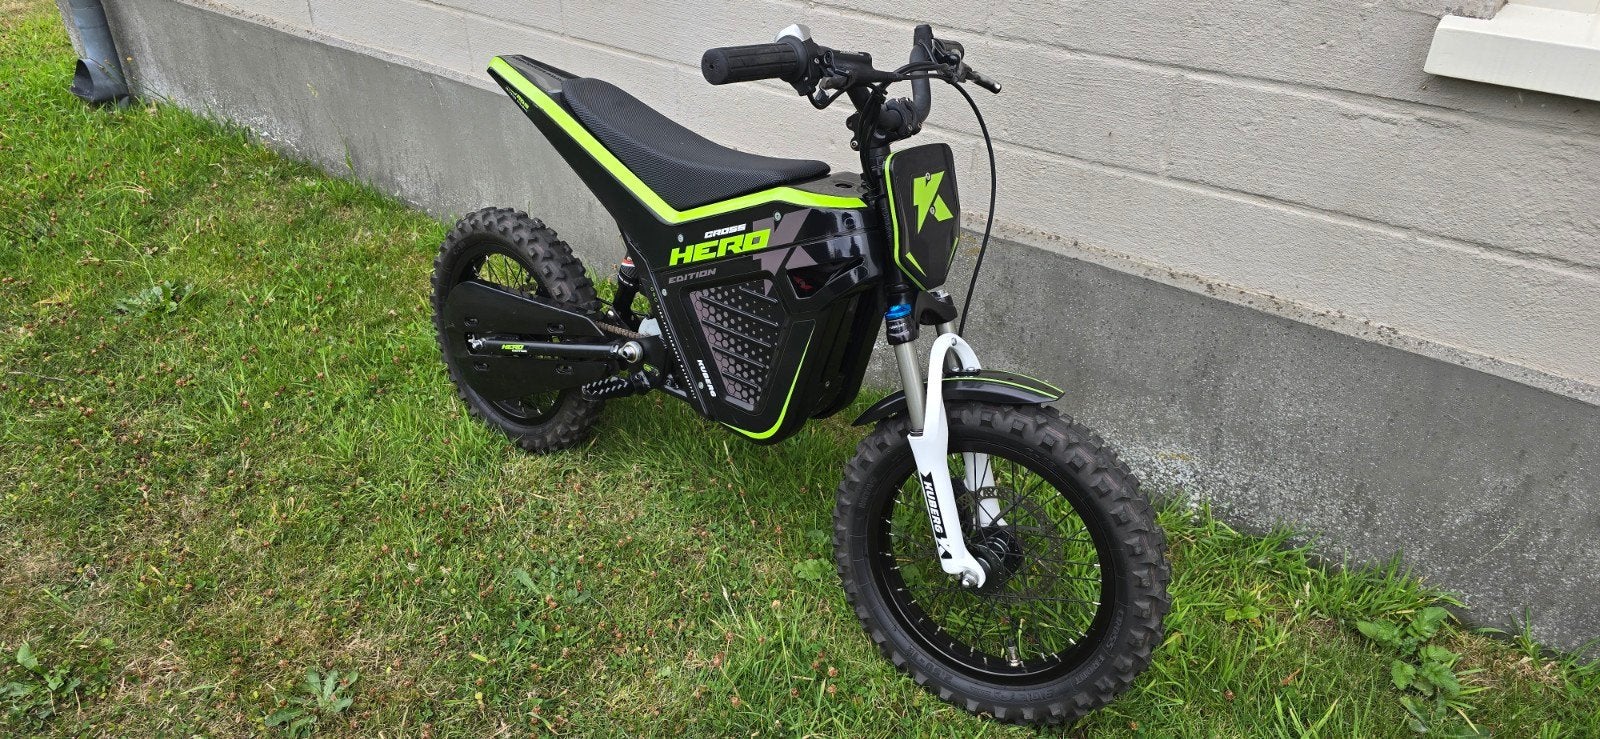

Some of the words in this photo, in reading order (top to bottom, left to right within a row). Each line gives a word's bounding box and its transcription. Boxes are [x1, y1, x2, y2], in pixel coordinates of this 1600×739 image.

[669, 228, 771, 266] HERO
[668, 268, 717, 284] EDITION
[697, 359, 717, 398] KUBERG
[923, 481, 944, 534] KUBERG
